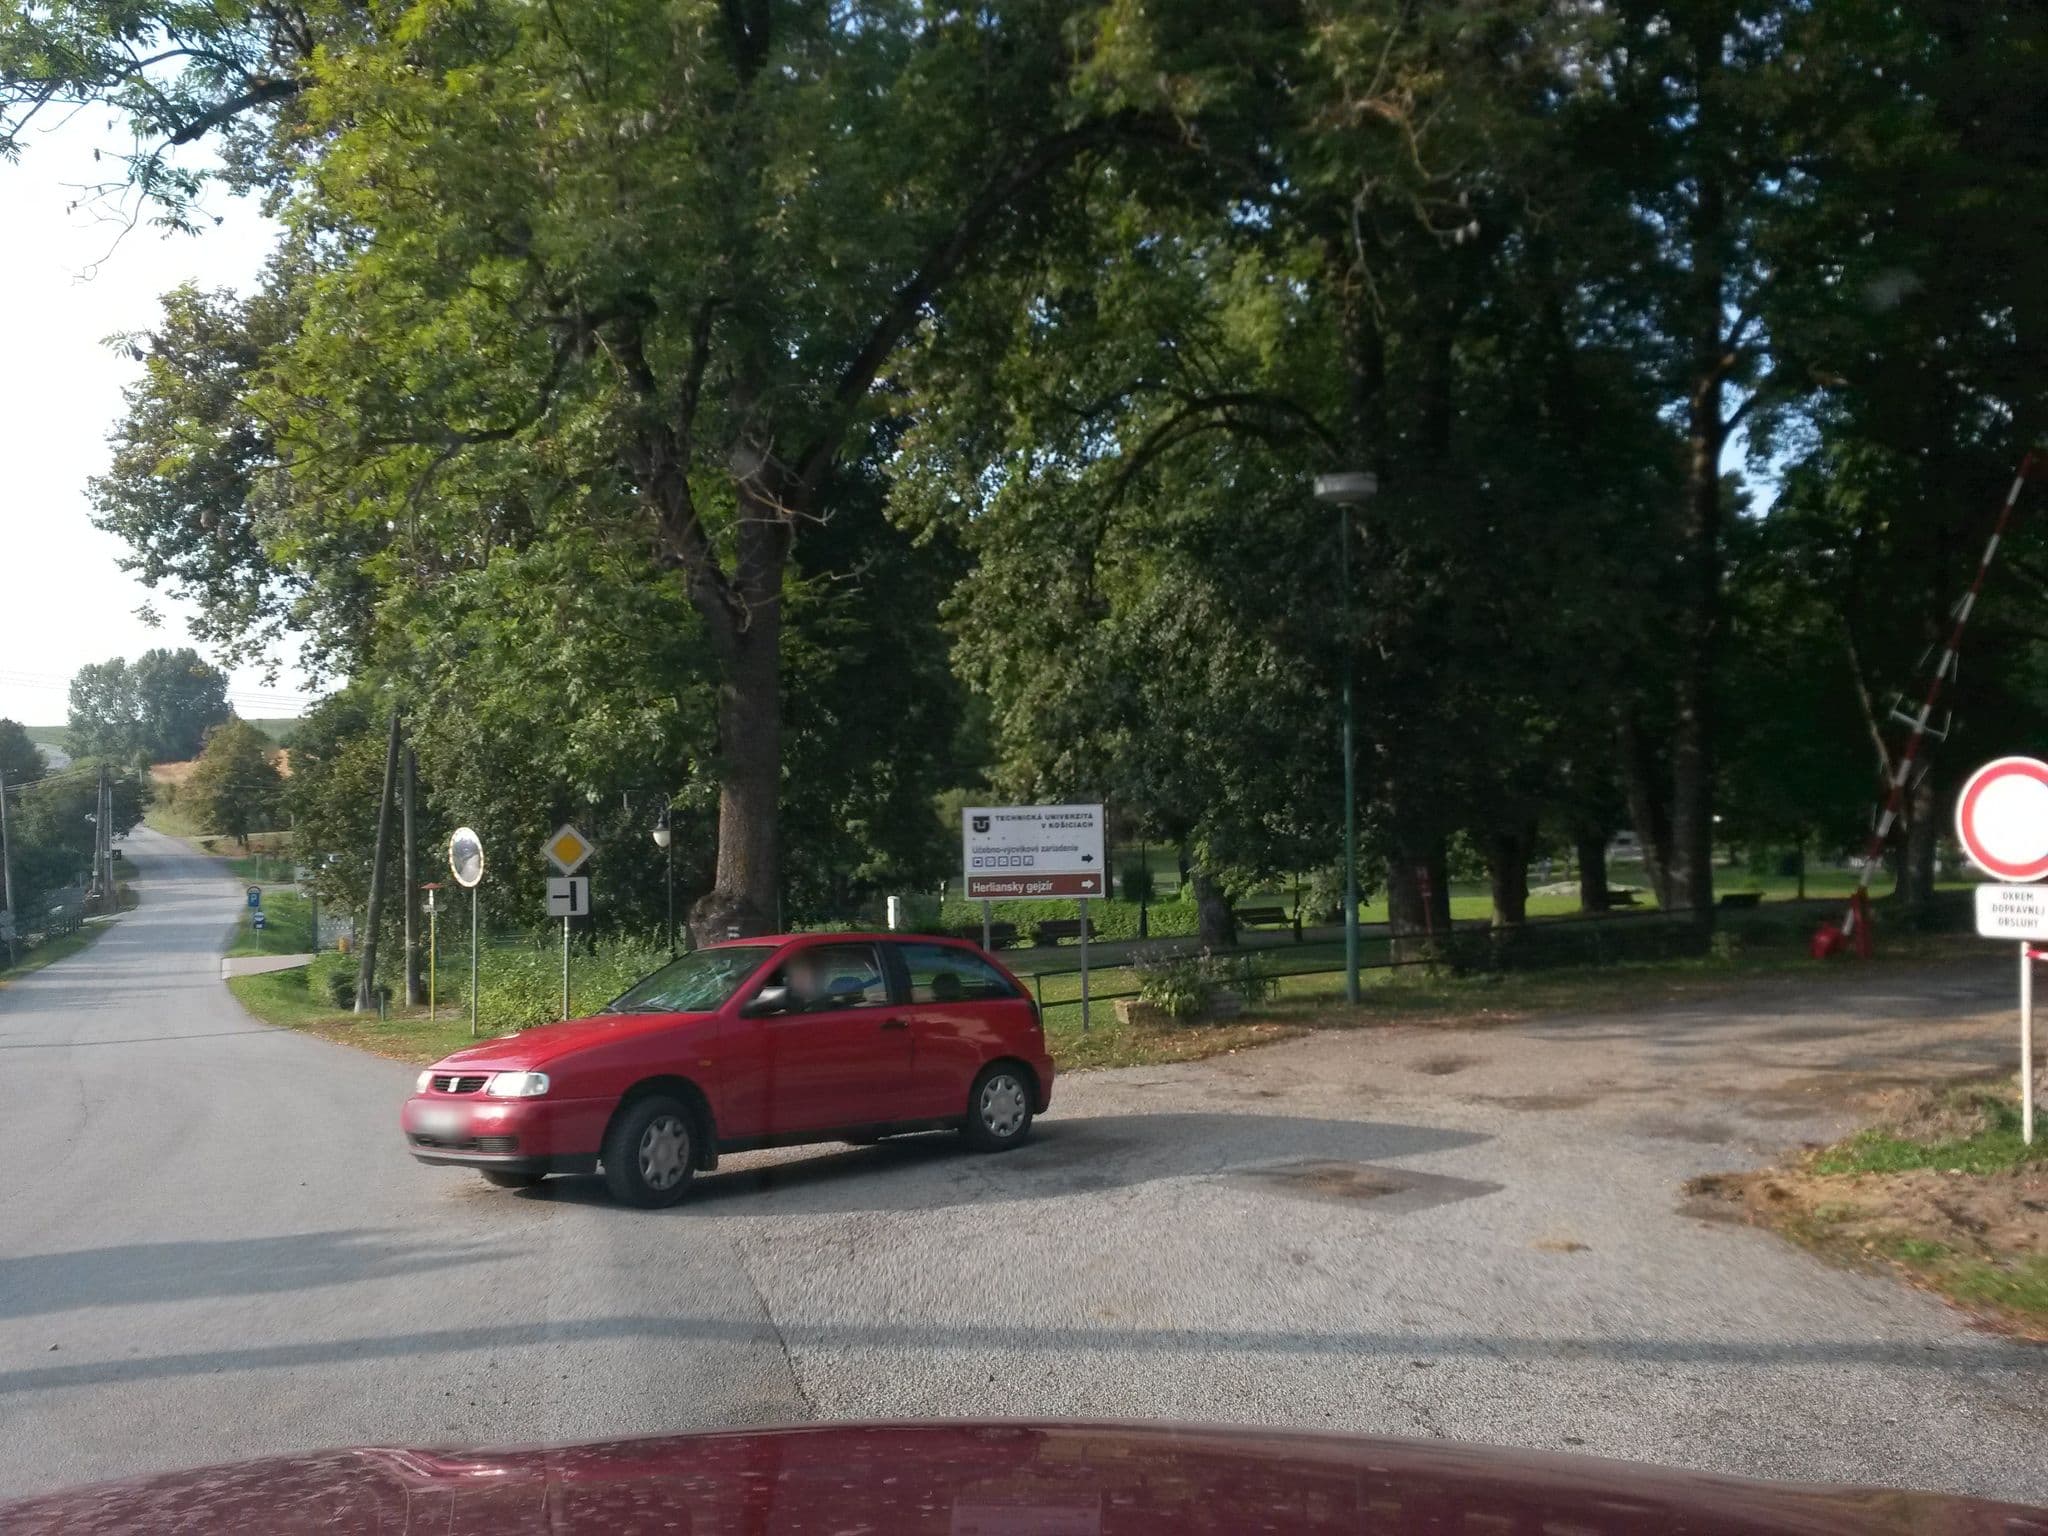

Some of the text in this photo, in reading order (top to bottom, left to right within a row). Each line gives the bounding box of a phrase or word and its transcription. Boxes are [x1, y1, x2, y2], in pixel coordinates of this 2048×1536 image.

[995, 813, 1094, 822] TECHNICKÁ UNIVERZITA
[1049, 821, 1094, 829] KOŠICIACH
[972, 880, 1054, 894] Herliansky gejzír
[1992, 903, 2046, 916] DOPRAVNEJ
[1998, 918, 2039, 928] OBSLUHY
